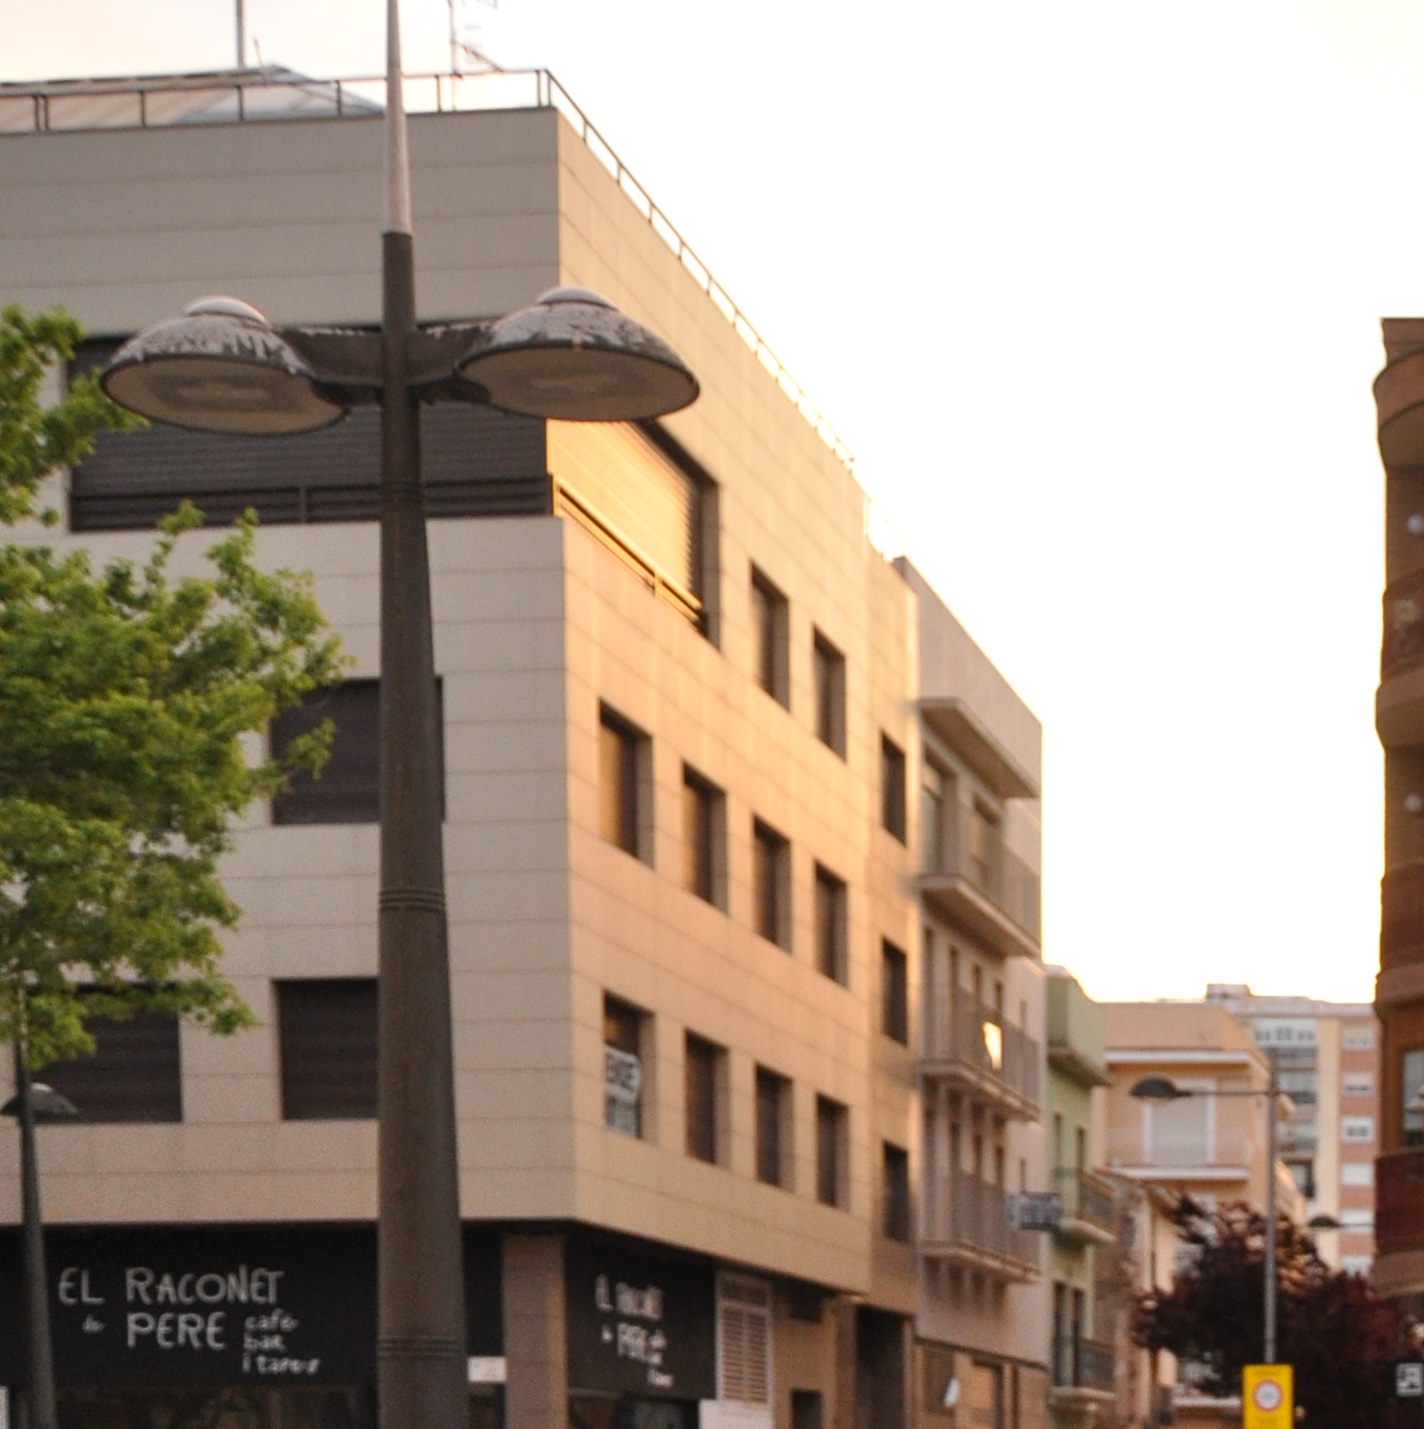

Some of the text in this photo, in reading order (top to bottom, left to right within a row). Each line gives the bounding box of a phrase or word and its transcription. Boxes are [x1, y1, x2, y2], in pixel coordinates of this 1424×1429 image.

[58, 1263, 285, 1306] EL RACONET
[126, 1310, 228, 1349] PERE
